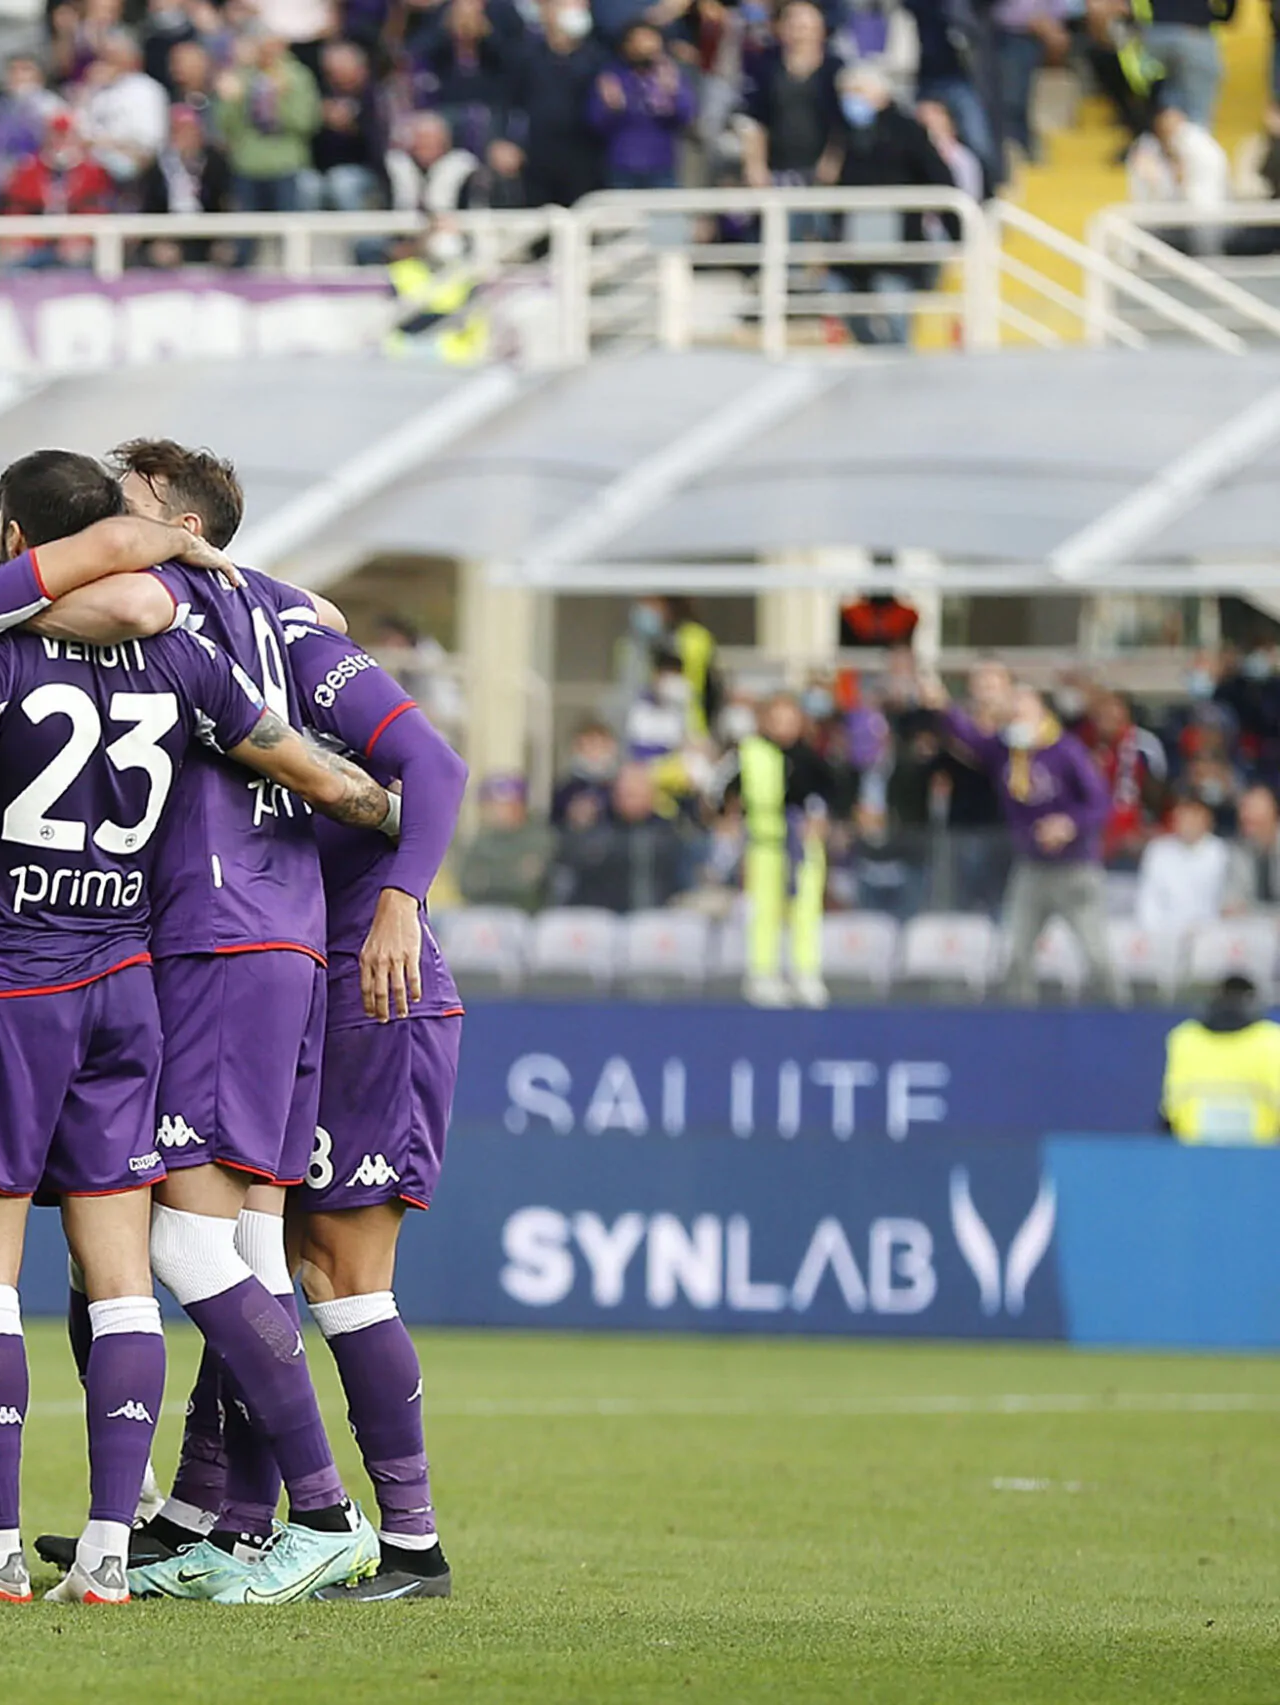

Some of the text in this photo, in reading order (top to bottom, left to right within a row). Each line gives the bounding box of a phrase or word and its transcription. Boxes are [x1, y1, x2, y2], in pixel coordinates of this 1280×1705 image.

[1, 682, 179, 855] 23
[8, 864, 144, 914] prima
[305, 1125, 334, 1190] 8
[499, 1204, 938, 1316] SYNLAB
